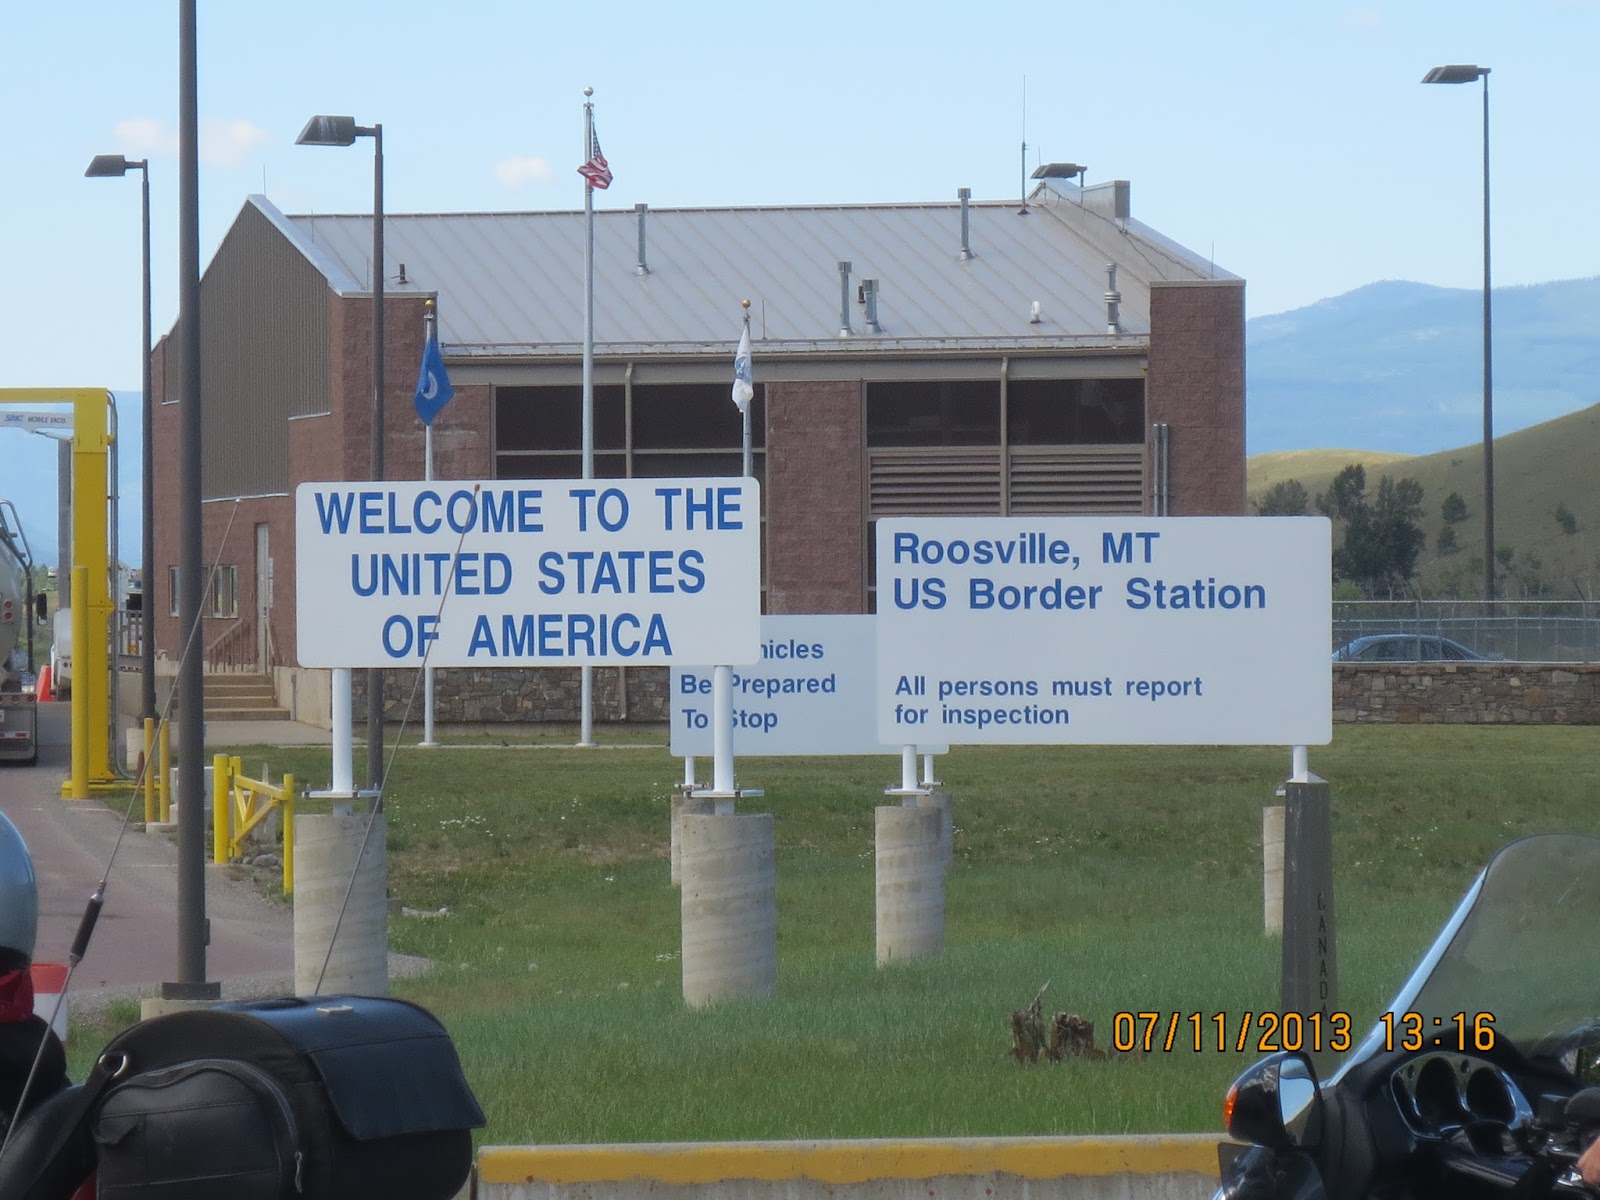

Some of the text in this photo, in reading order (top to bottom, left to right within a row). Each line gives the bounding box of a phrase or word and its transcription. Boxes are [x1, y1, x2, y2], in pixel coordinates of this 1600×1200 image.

[315, 487, 743, 535] WELCOME TO THE
[893, 531, 1161, 570] Roosville, MT
[351, 549, 706, 597] UNITED STATES
[893, 577, 1267, 611] US Border Station
[382, 613, 673, 659] OF AMERICA
[680, 674, 712, 695] Be
[895, 675, 1203, 703] All persons must report
[681, 708, 708, 729] To
[895, 704, 1070, 730] for inspection
[1317, 891, 1329, 1023] CANADA
